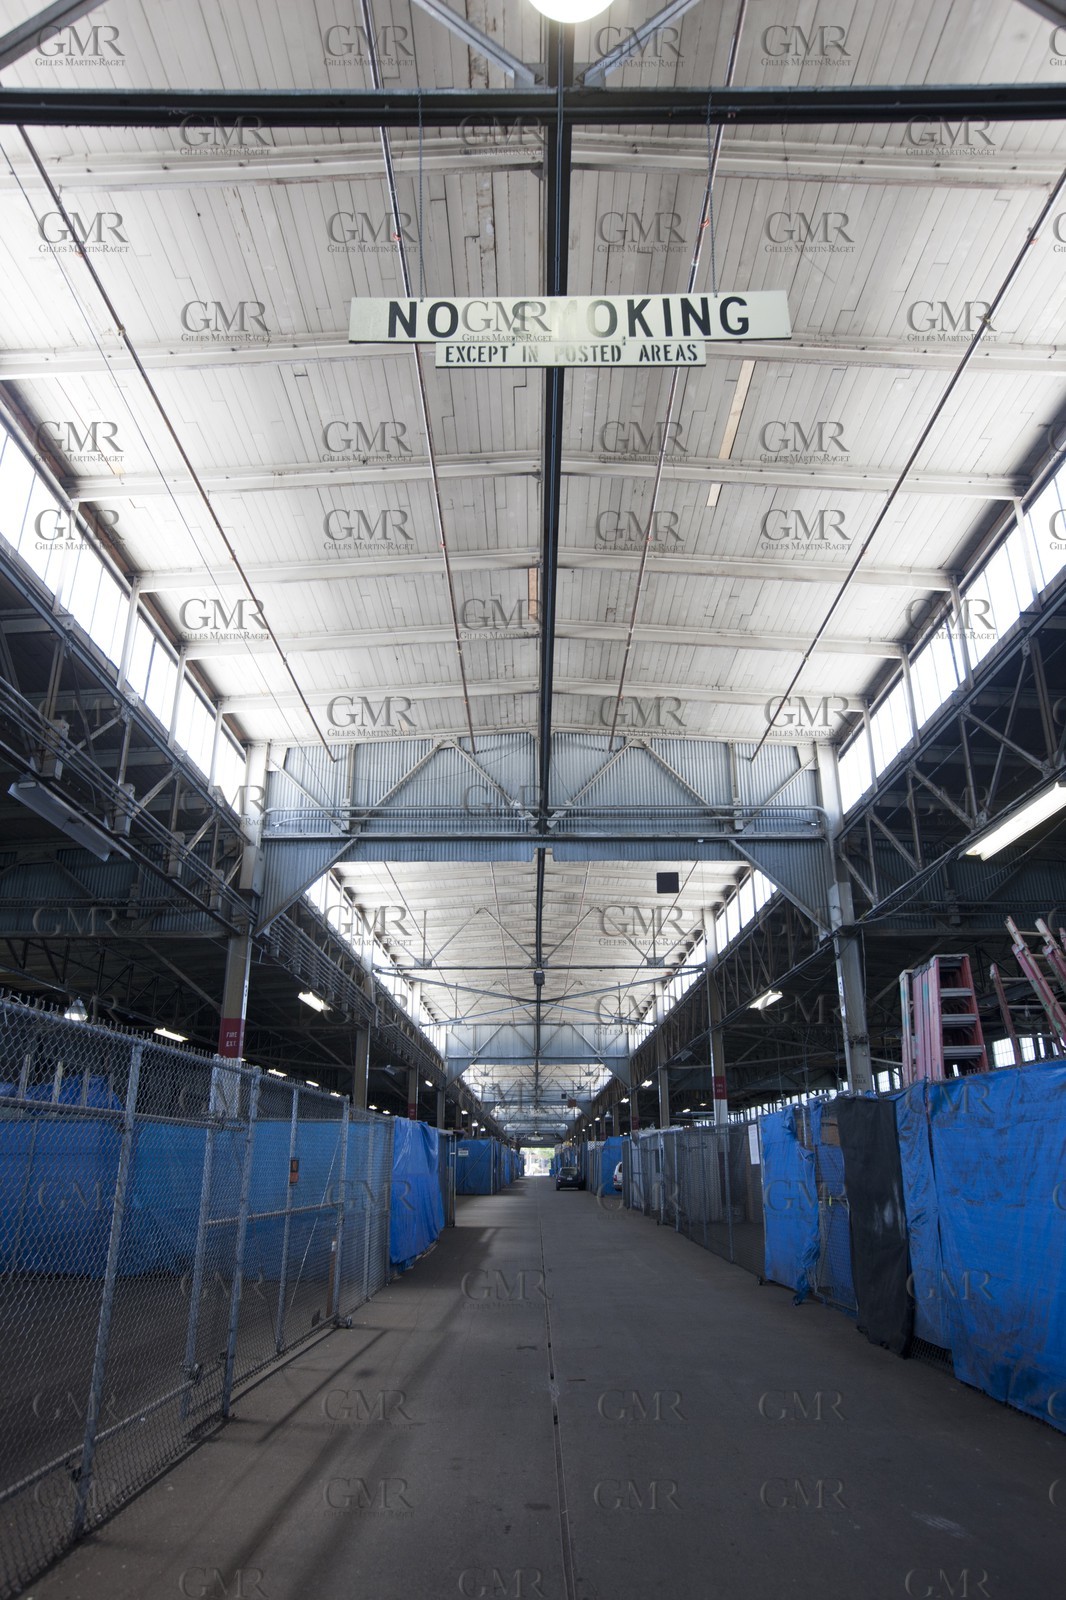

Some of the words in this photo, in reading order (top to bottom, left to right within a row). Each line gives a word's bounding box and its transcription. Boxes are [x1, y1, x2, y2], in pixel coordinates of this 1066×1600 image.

[388, 301, 459, 338] NO
[445, 345, 508, 363] EXCEPT
[522, 345, 539, 363] IN
[554, 344, 622, 363] POSTED
[638, 343, 698, 363] AREAS
